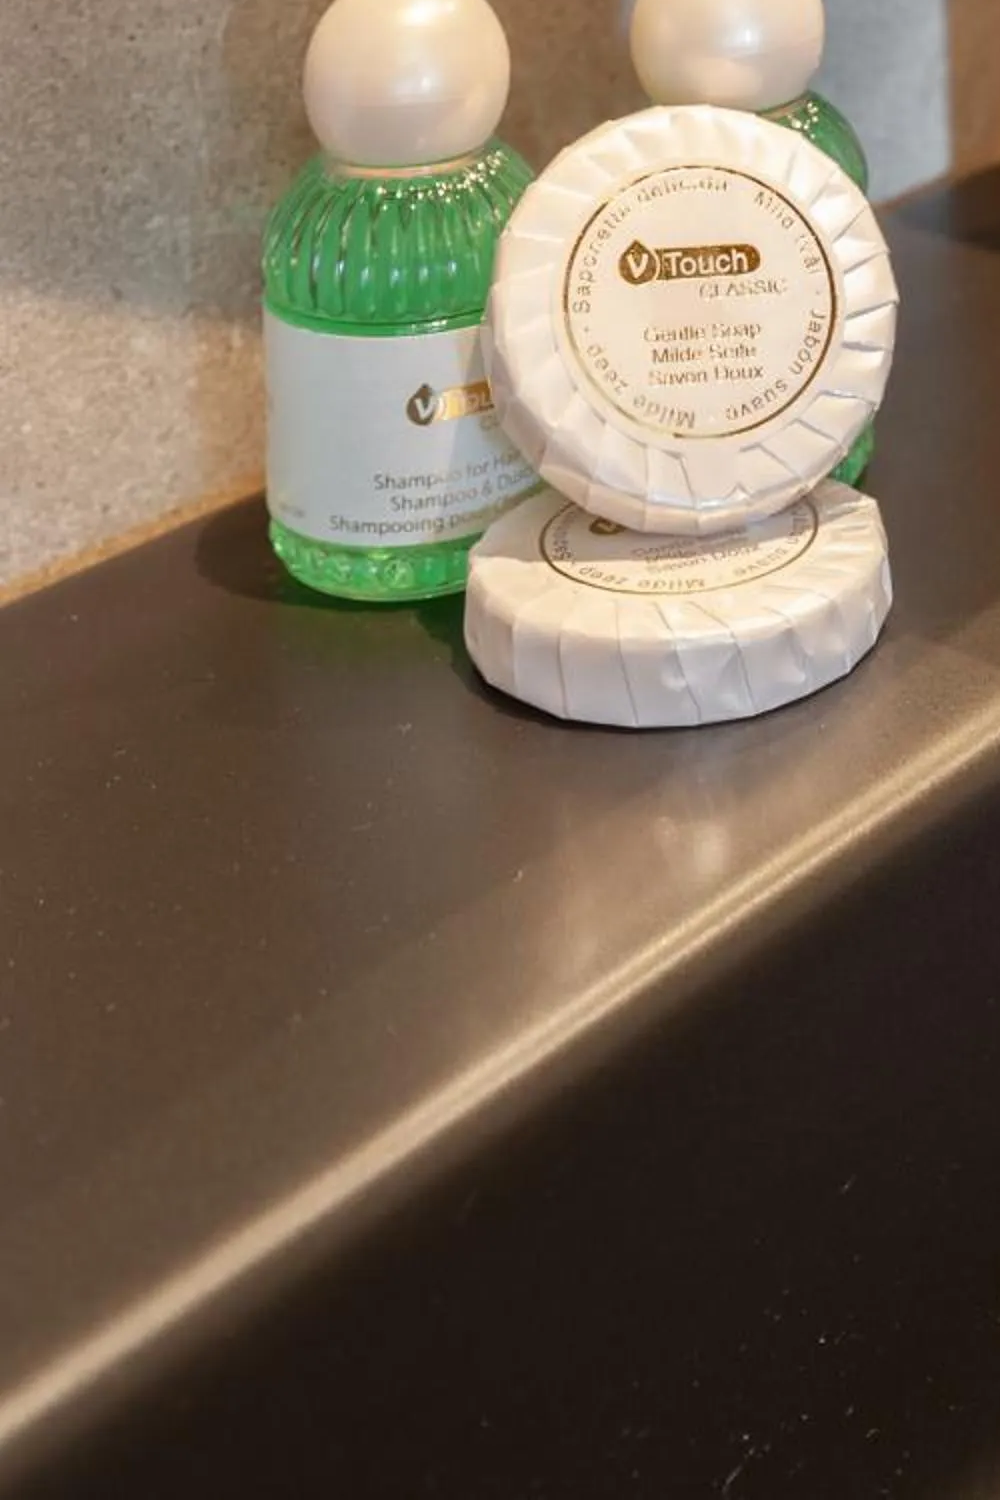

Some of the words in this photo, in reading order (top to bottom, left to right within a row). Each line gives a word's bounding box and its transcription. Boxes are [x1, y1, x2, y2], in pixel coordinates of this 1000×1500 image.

[663, 249, 749, 277] Touch
[699, 278, 788, 299] CLASSIC
[643, 325, 706, 342] Gentle
[711, 321, 762, 340] Soap
[652, 346, 703, 364] Milde
[648, 369, 709, 386] Savon
[714, 365, 765, 380] Doux
[725, 378, 789, 422] suave
[466, 462, 490, 480] for
[389, 487, 479, 513] Shampoo
[328, 513, 446, 537] Shampooing
